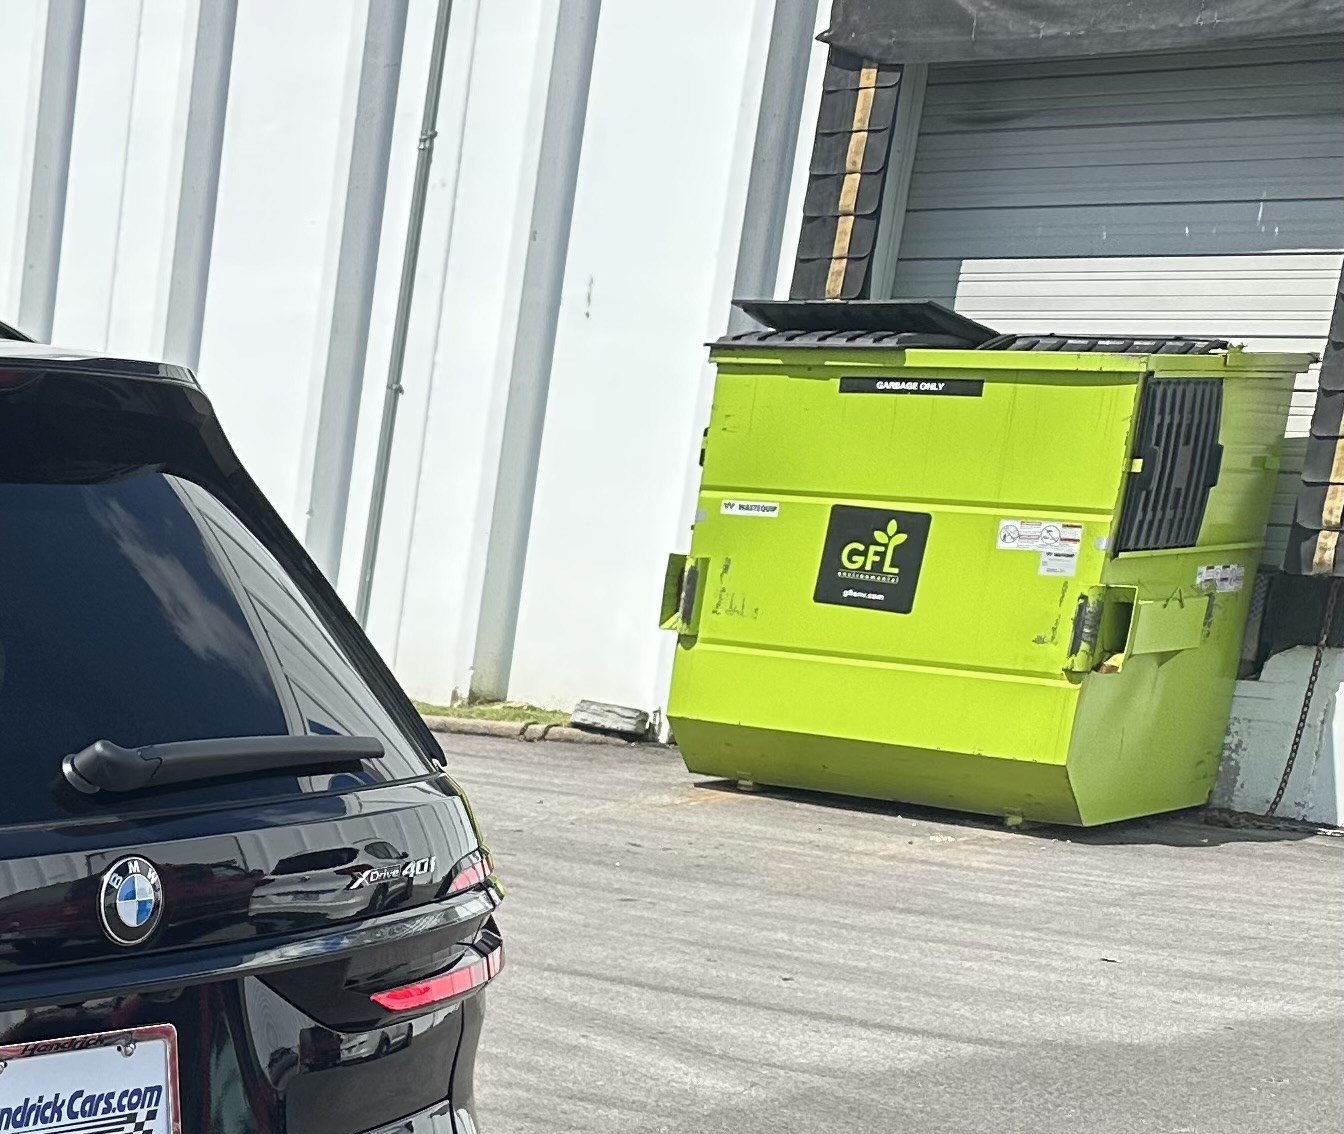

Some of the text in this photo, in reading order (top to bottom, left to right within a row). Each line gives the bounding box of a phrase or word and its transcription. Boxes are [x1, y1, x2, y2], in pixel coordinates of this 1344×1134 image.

[876, 380, 945, 391] GARBAGE ONLY
[841, 534, 902, 574] GFL
[108, 859, 159, 889] BMW
